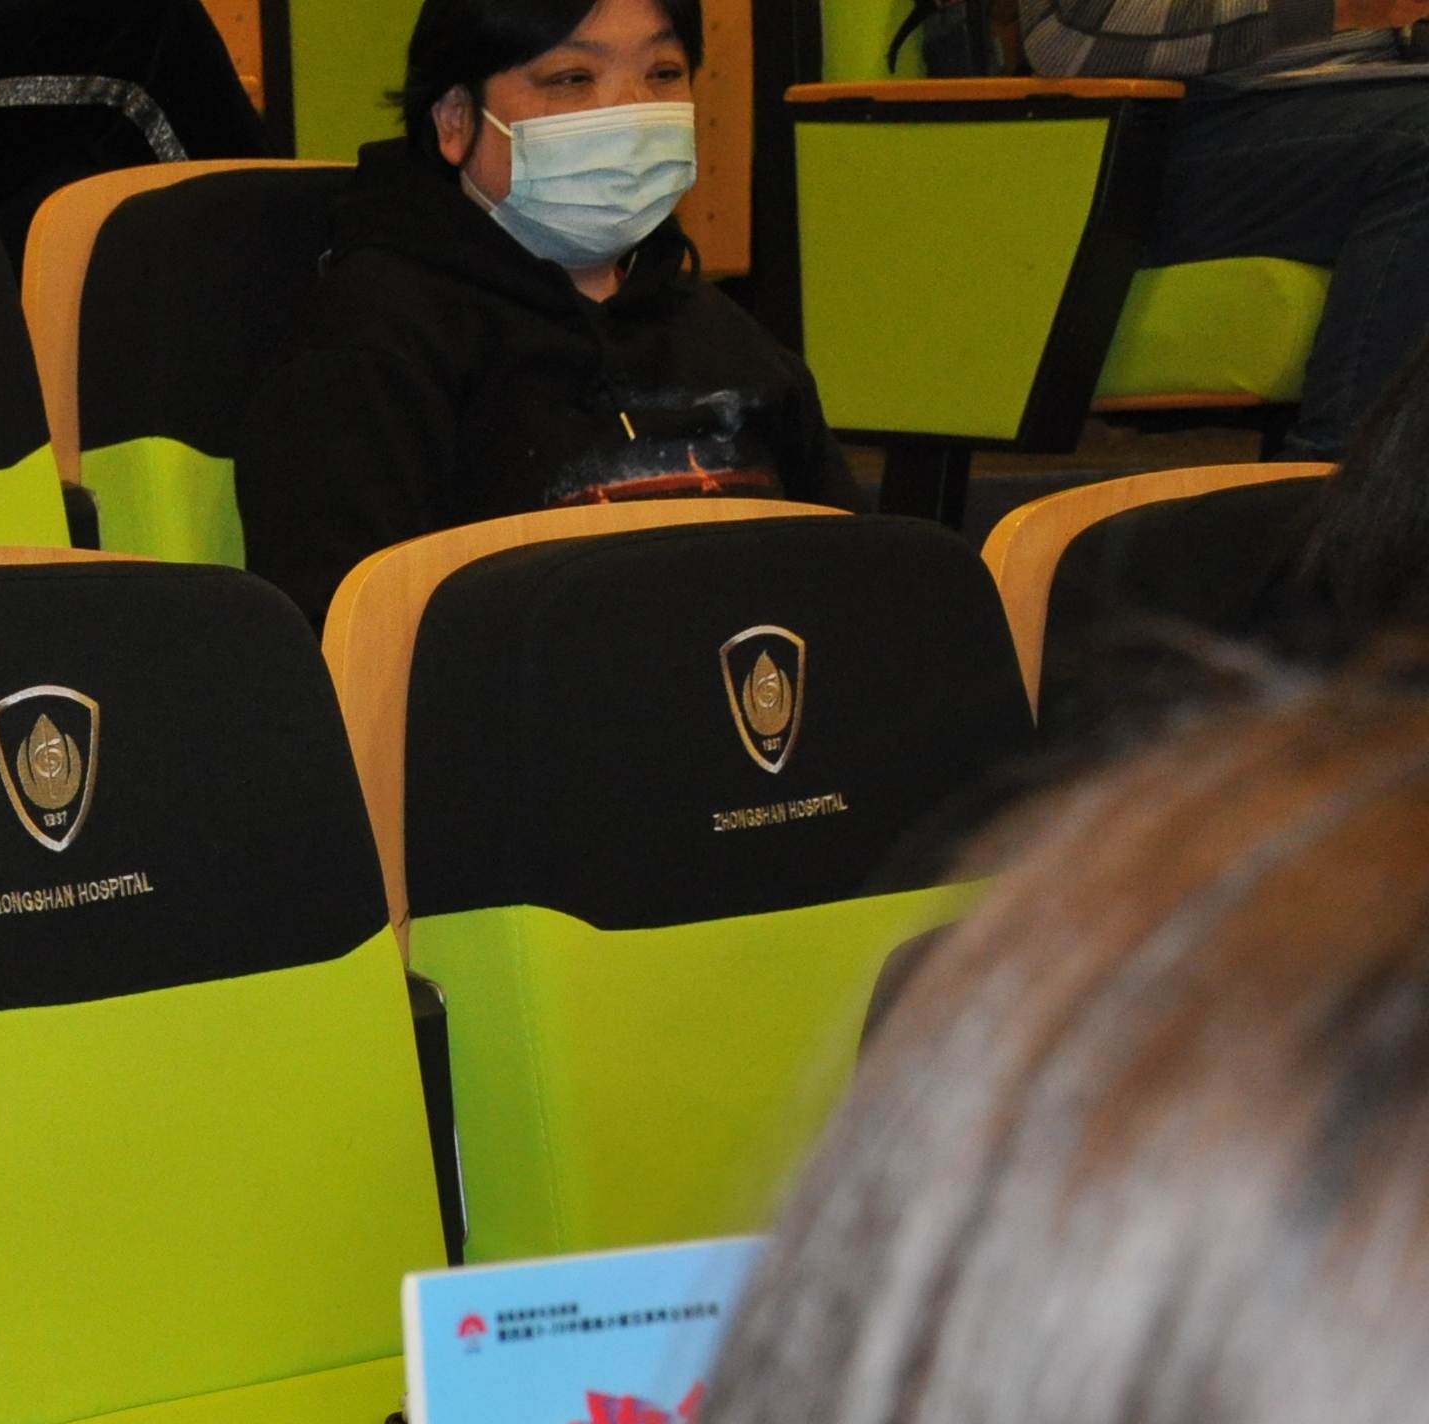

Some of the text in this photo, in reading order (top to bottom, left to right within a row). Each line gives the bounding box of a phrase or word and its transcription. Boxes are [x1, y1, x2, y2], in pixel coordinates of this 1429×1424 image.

[712, 793, 848, 831] ZHONGSHAN HOSPITAL
[77, 871, 154, 904] HOSPITAL
